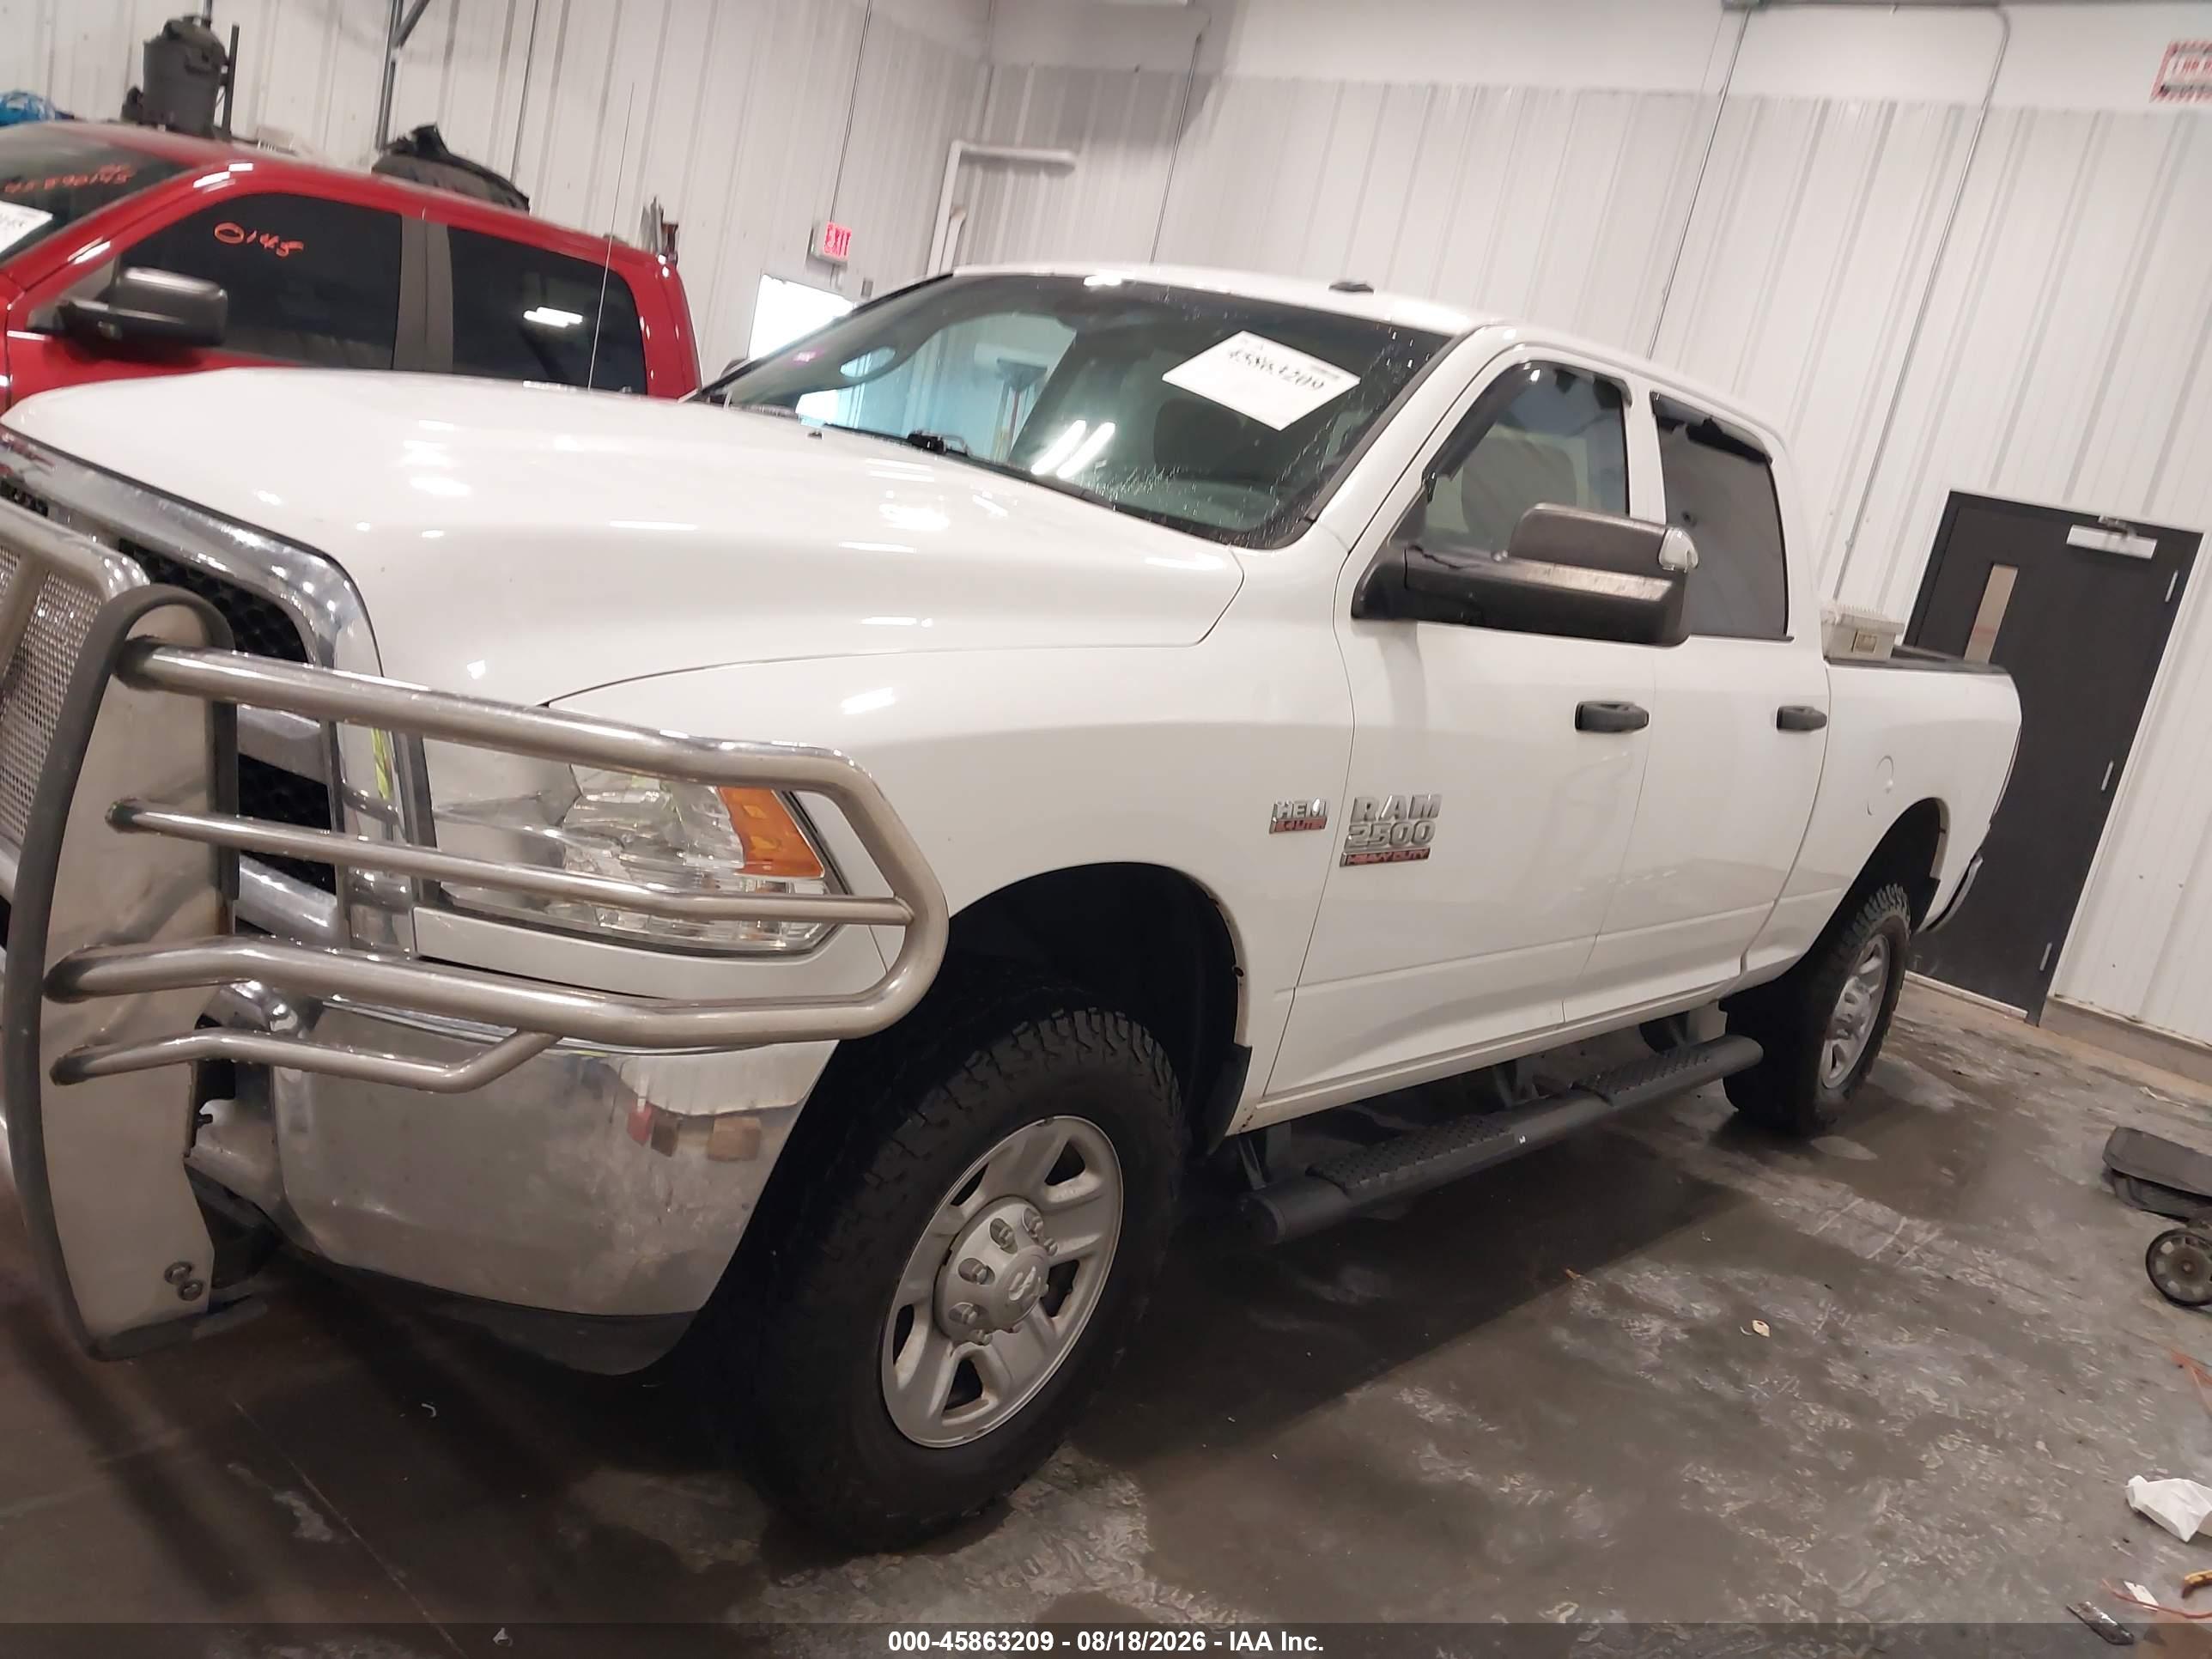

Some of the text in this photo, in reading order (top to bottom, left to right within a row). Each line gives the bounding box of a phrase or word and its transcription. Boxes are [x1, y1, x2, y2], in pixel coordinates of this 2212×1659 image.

[214, 222, 304, 257] 0145
[824, 224, 851, 257] EXIT
[1350, 794, 1442, 822] RAM
[1345, 820, 1437, 848] 2500
